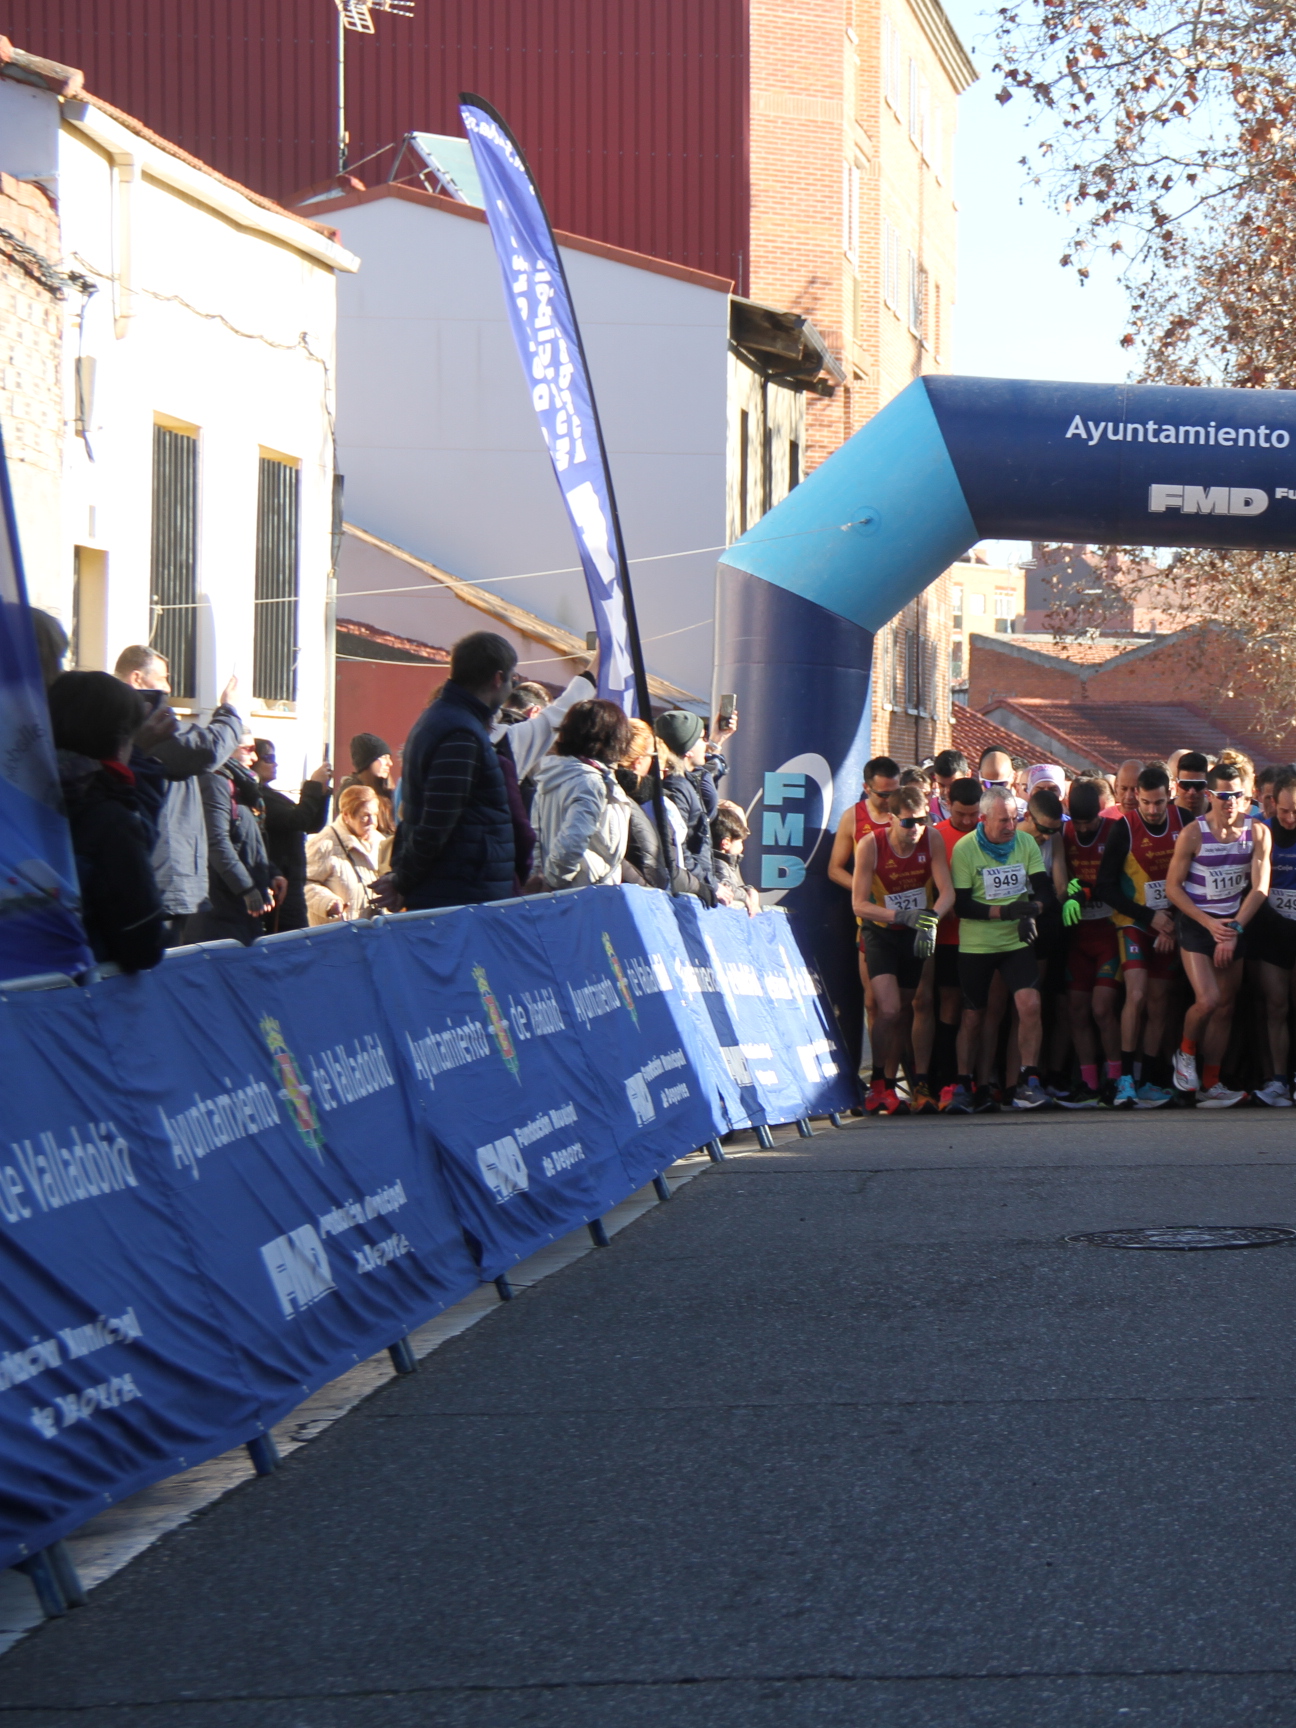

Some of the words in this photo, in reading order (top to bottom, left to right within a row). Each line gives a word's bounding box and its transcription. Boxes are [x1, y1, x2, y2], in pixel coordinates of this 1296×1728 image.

[1065, 414, 1291, 449] Ayuntamiento
[1148, 483, 1270, 518] FMD
[761, 771, 807, 889] FMD
[993, 873, 1019, 889] 949
[1211, 874, 1243, 890] 1110
[894, 897, 919, 911] 321
[404, 1013, 491, 1091] Ayuntamiento
[157, 1072, 281, 1181] Ayuntamiento
[320, 1032, 397, 1105] Valladolid
